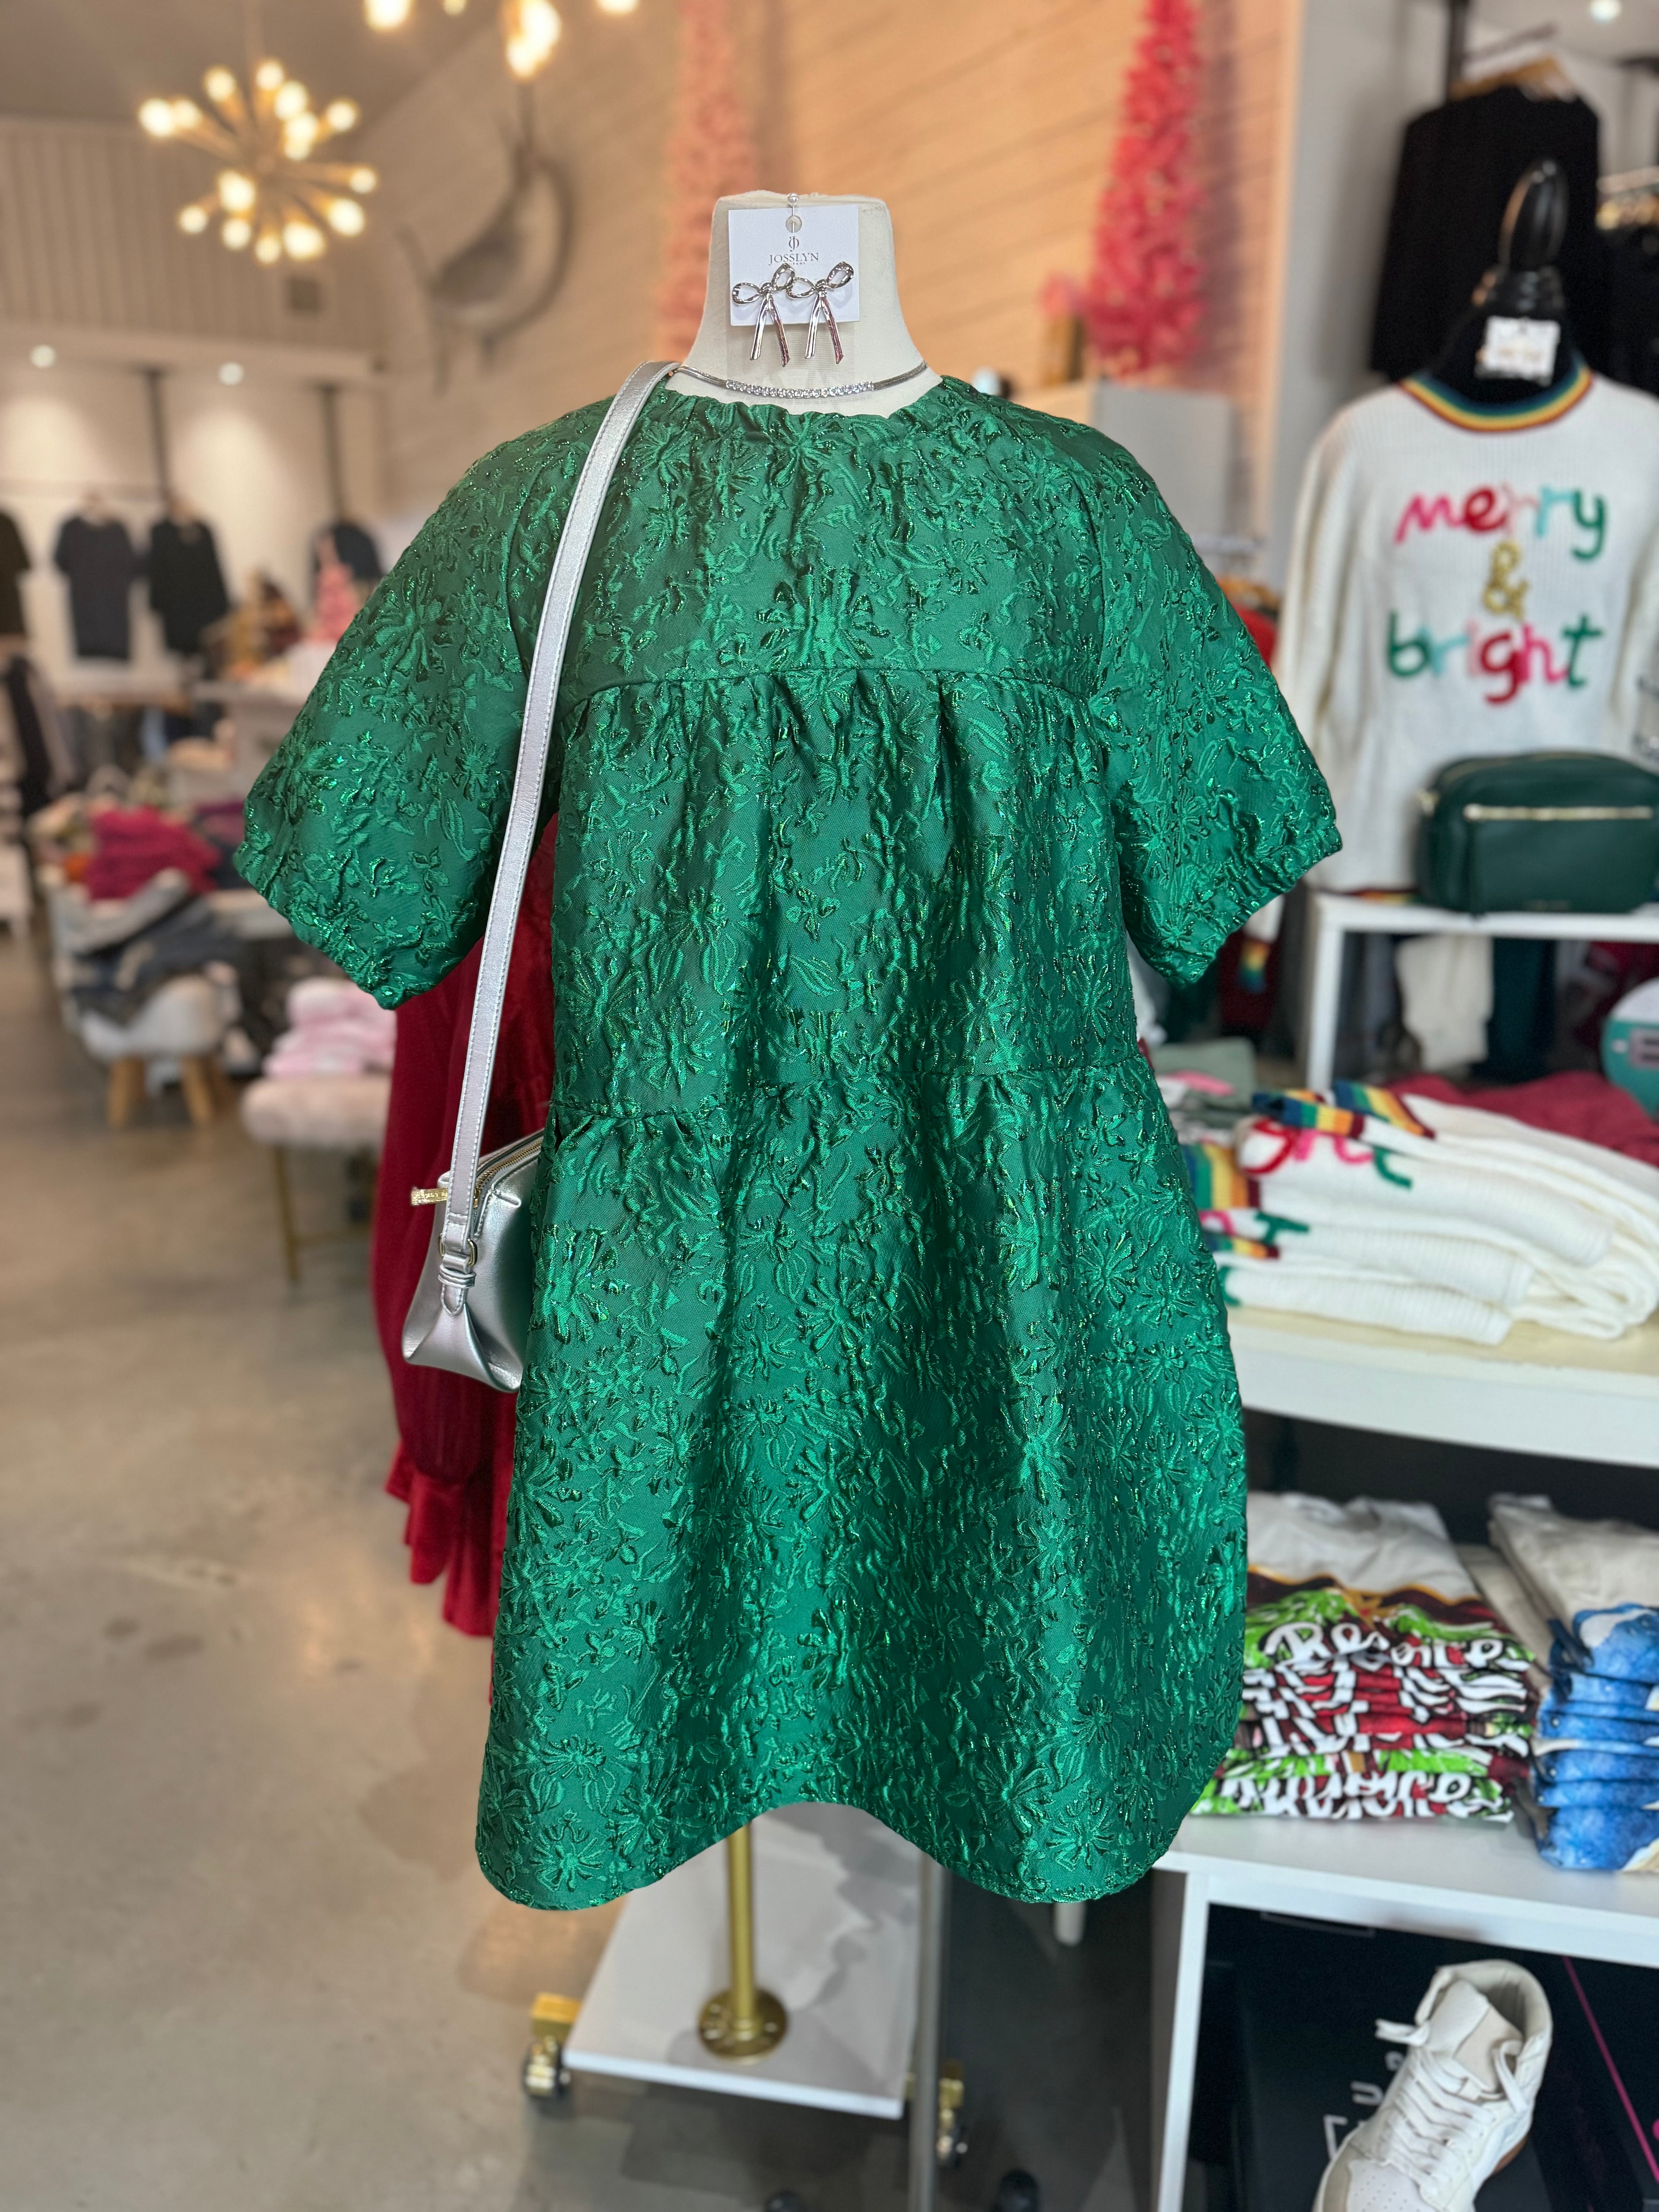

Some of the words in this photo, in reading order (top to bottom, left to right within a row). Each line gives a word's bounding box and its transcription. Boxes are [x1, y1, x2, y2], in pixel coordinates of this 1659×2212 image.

[768, 253, 819, 266] JOSSLYN
[1394, 483, 1607, 562] merry
[1482, 539, 1530, 622] &
[1387, 607, 1604, 707] bright
